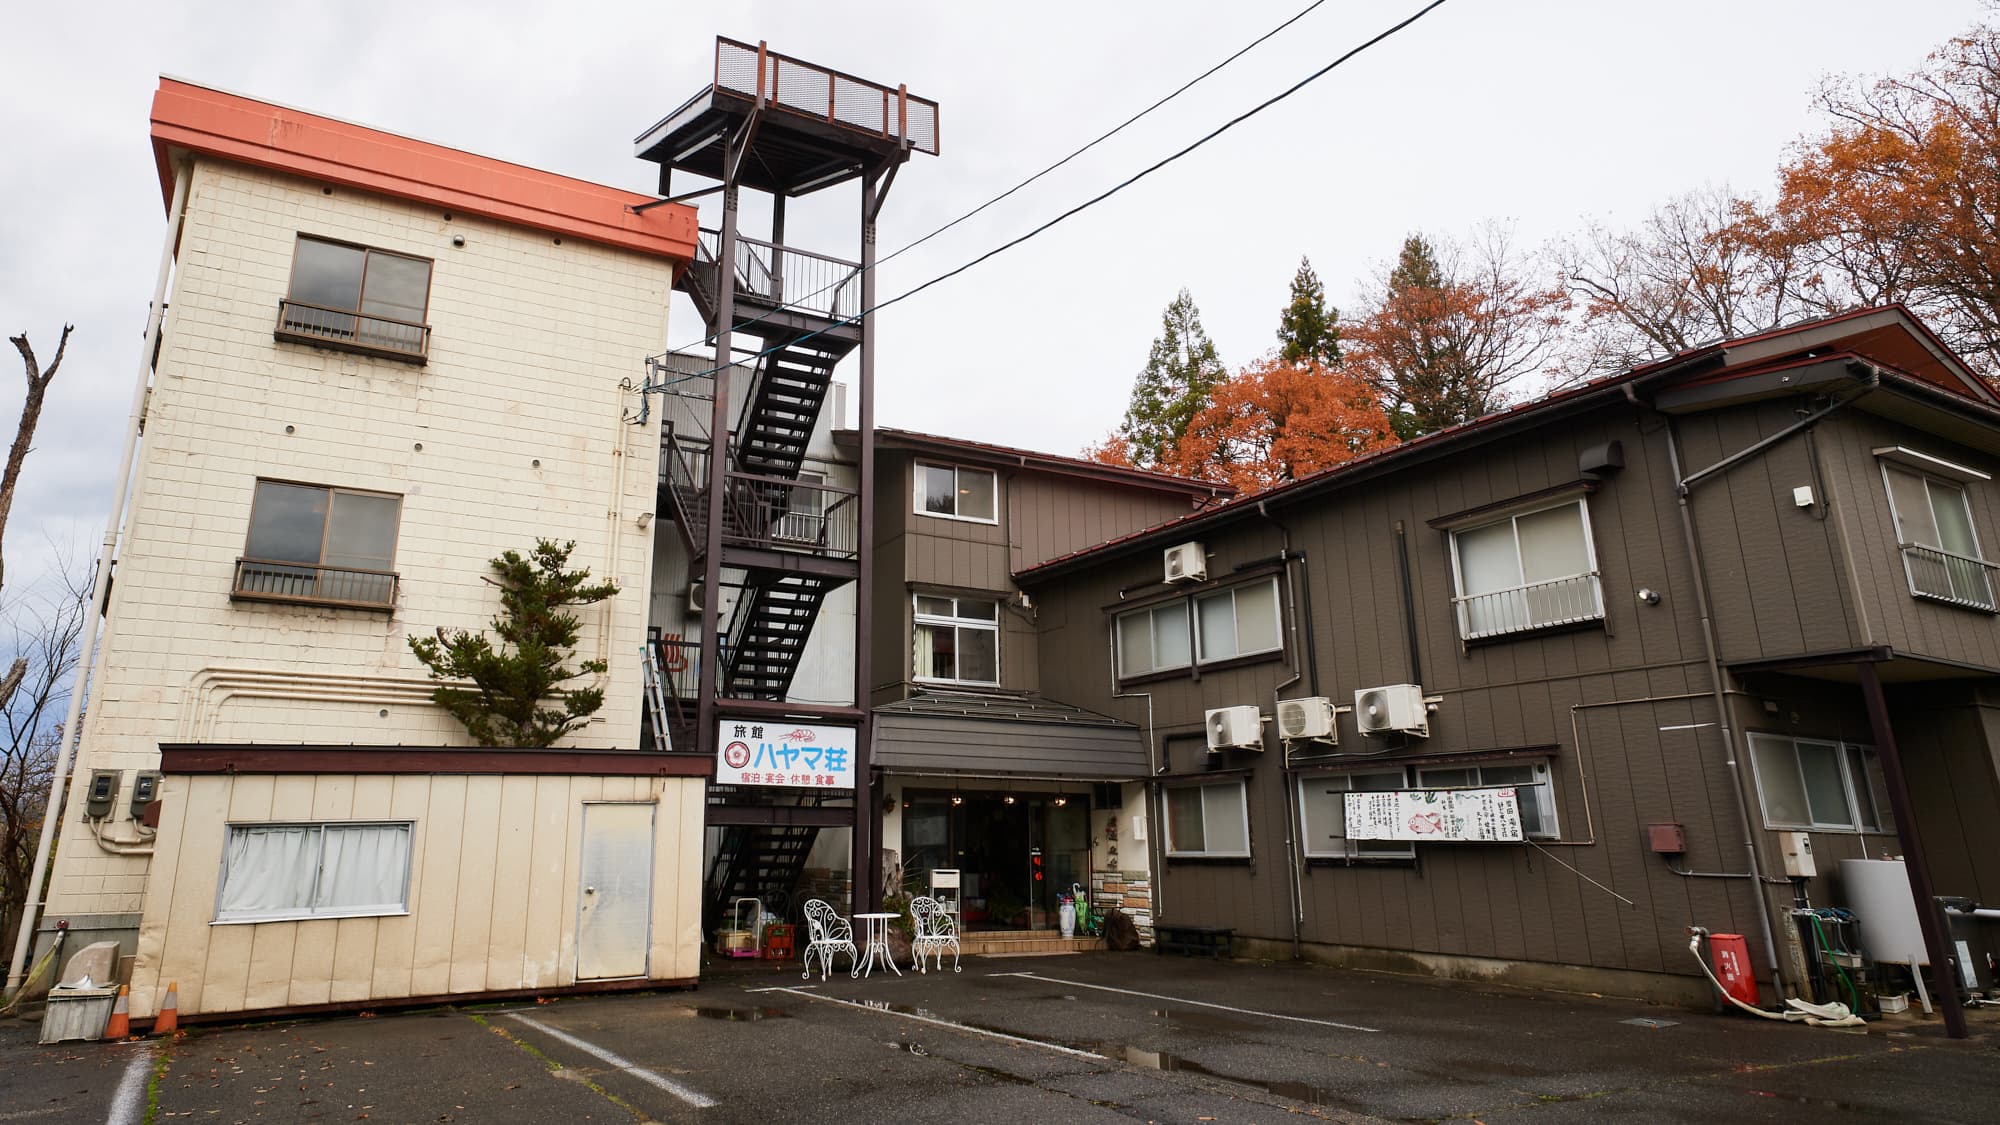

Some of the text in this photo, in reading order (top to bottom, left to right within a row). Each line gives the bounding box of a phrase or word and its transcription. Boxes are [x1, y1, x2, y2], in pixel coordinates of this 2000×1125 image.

[734, 725, 763, 739] 旅館
[754, 743, 847, 772] ハヤマ荘
